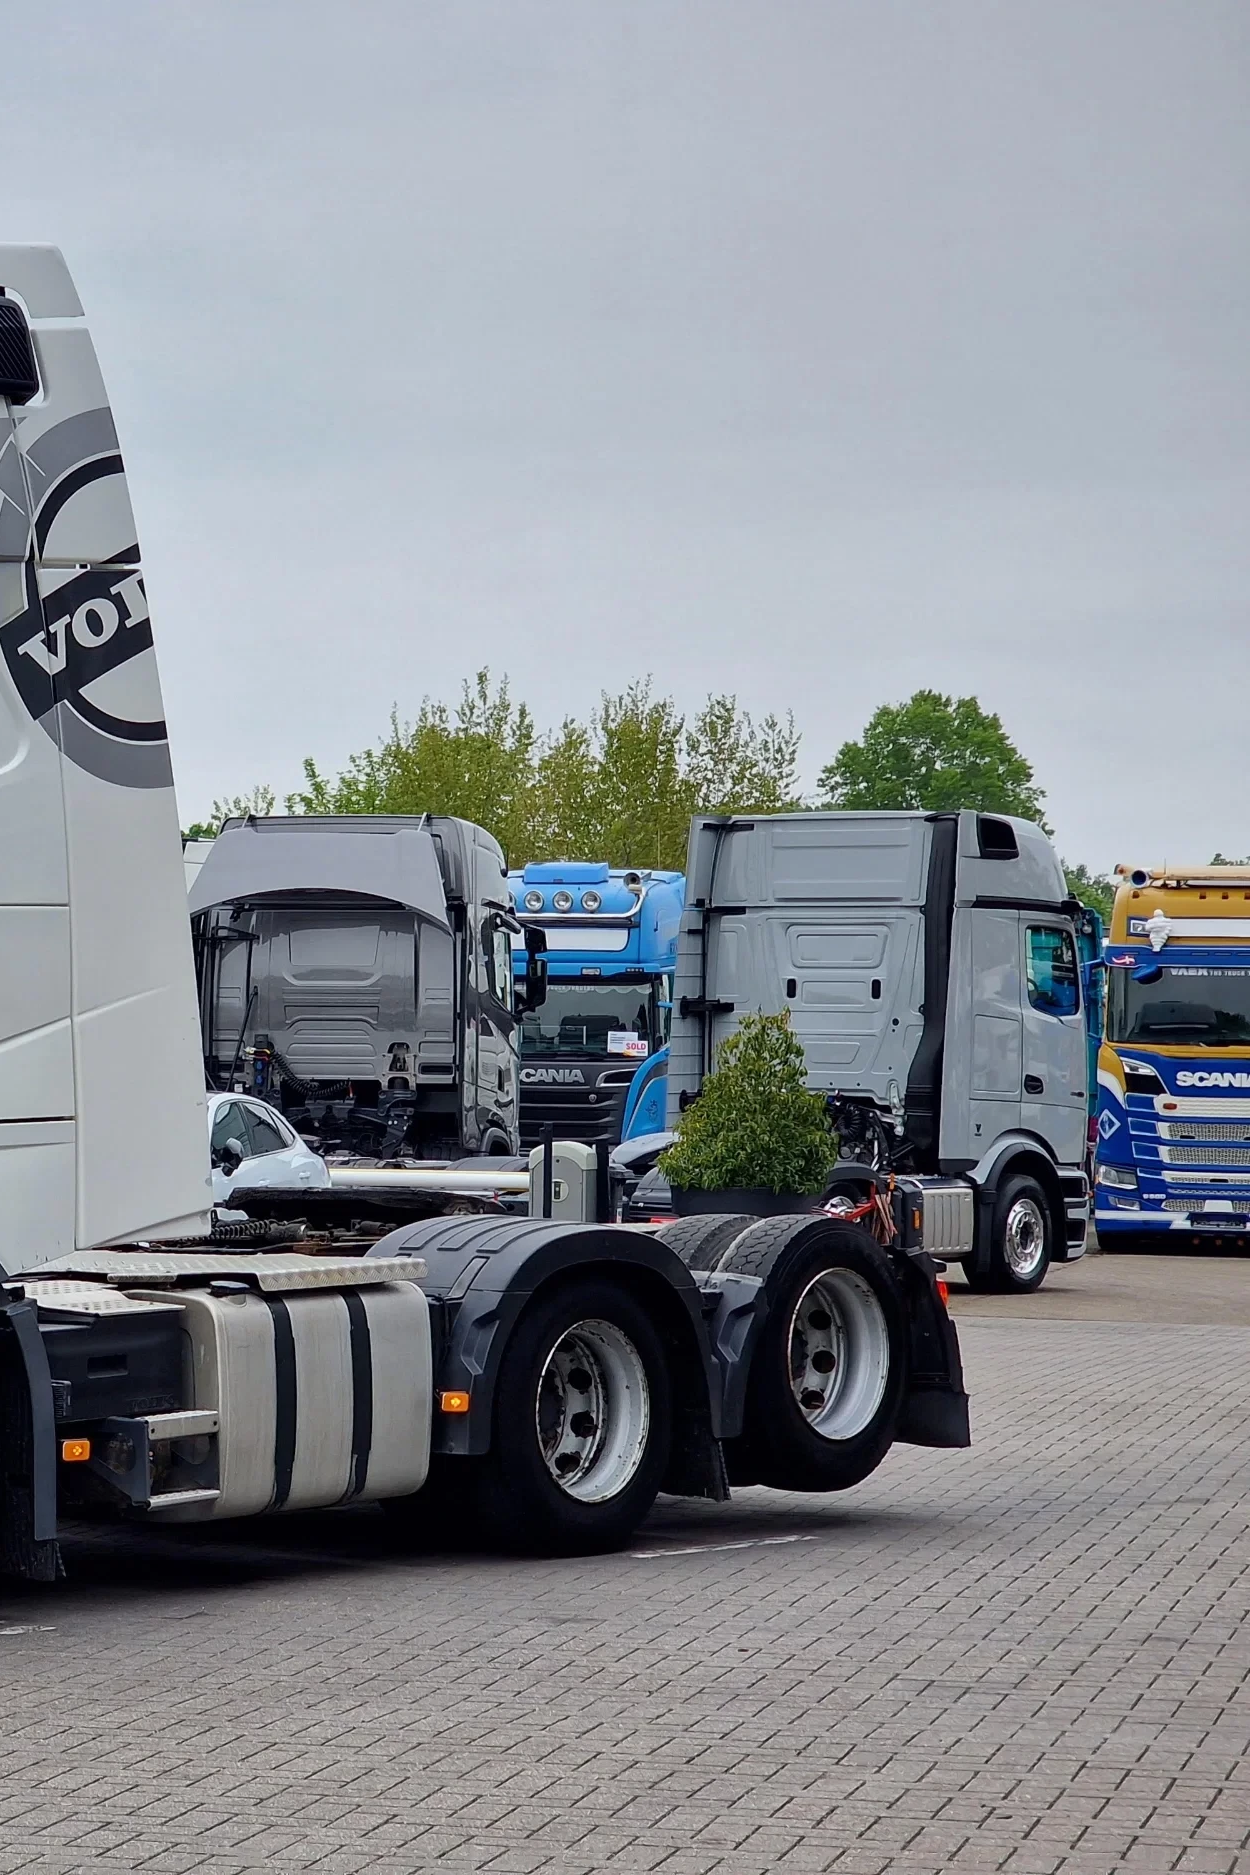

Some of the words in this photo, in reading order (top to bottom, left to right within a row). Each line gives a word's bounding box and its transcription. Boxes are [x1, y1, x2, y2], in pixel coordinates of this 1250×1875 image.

[17, 571, 150, 676] VOL
[625, 1042, 647, 1050] SOLD
[519, 1068, 585, 1083] CANIA
